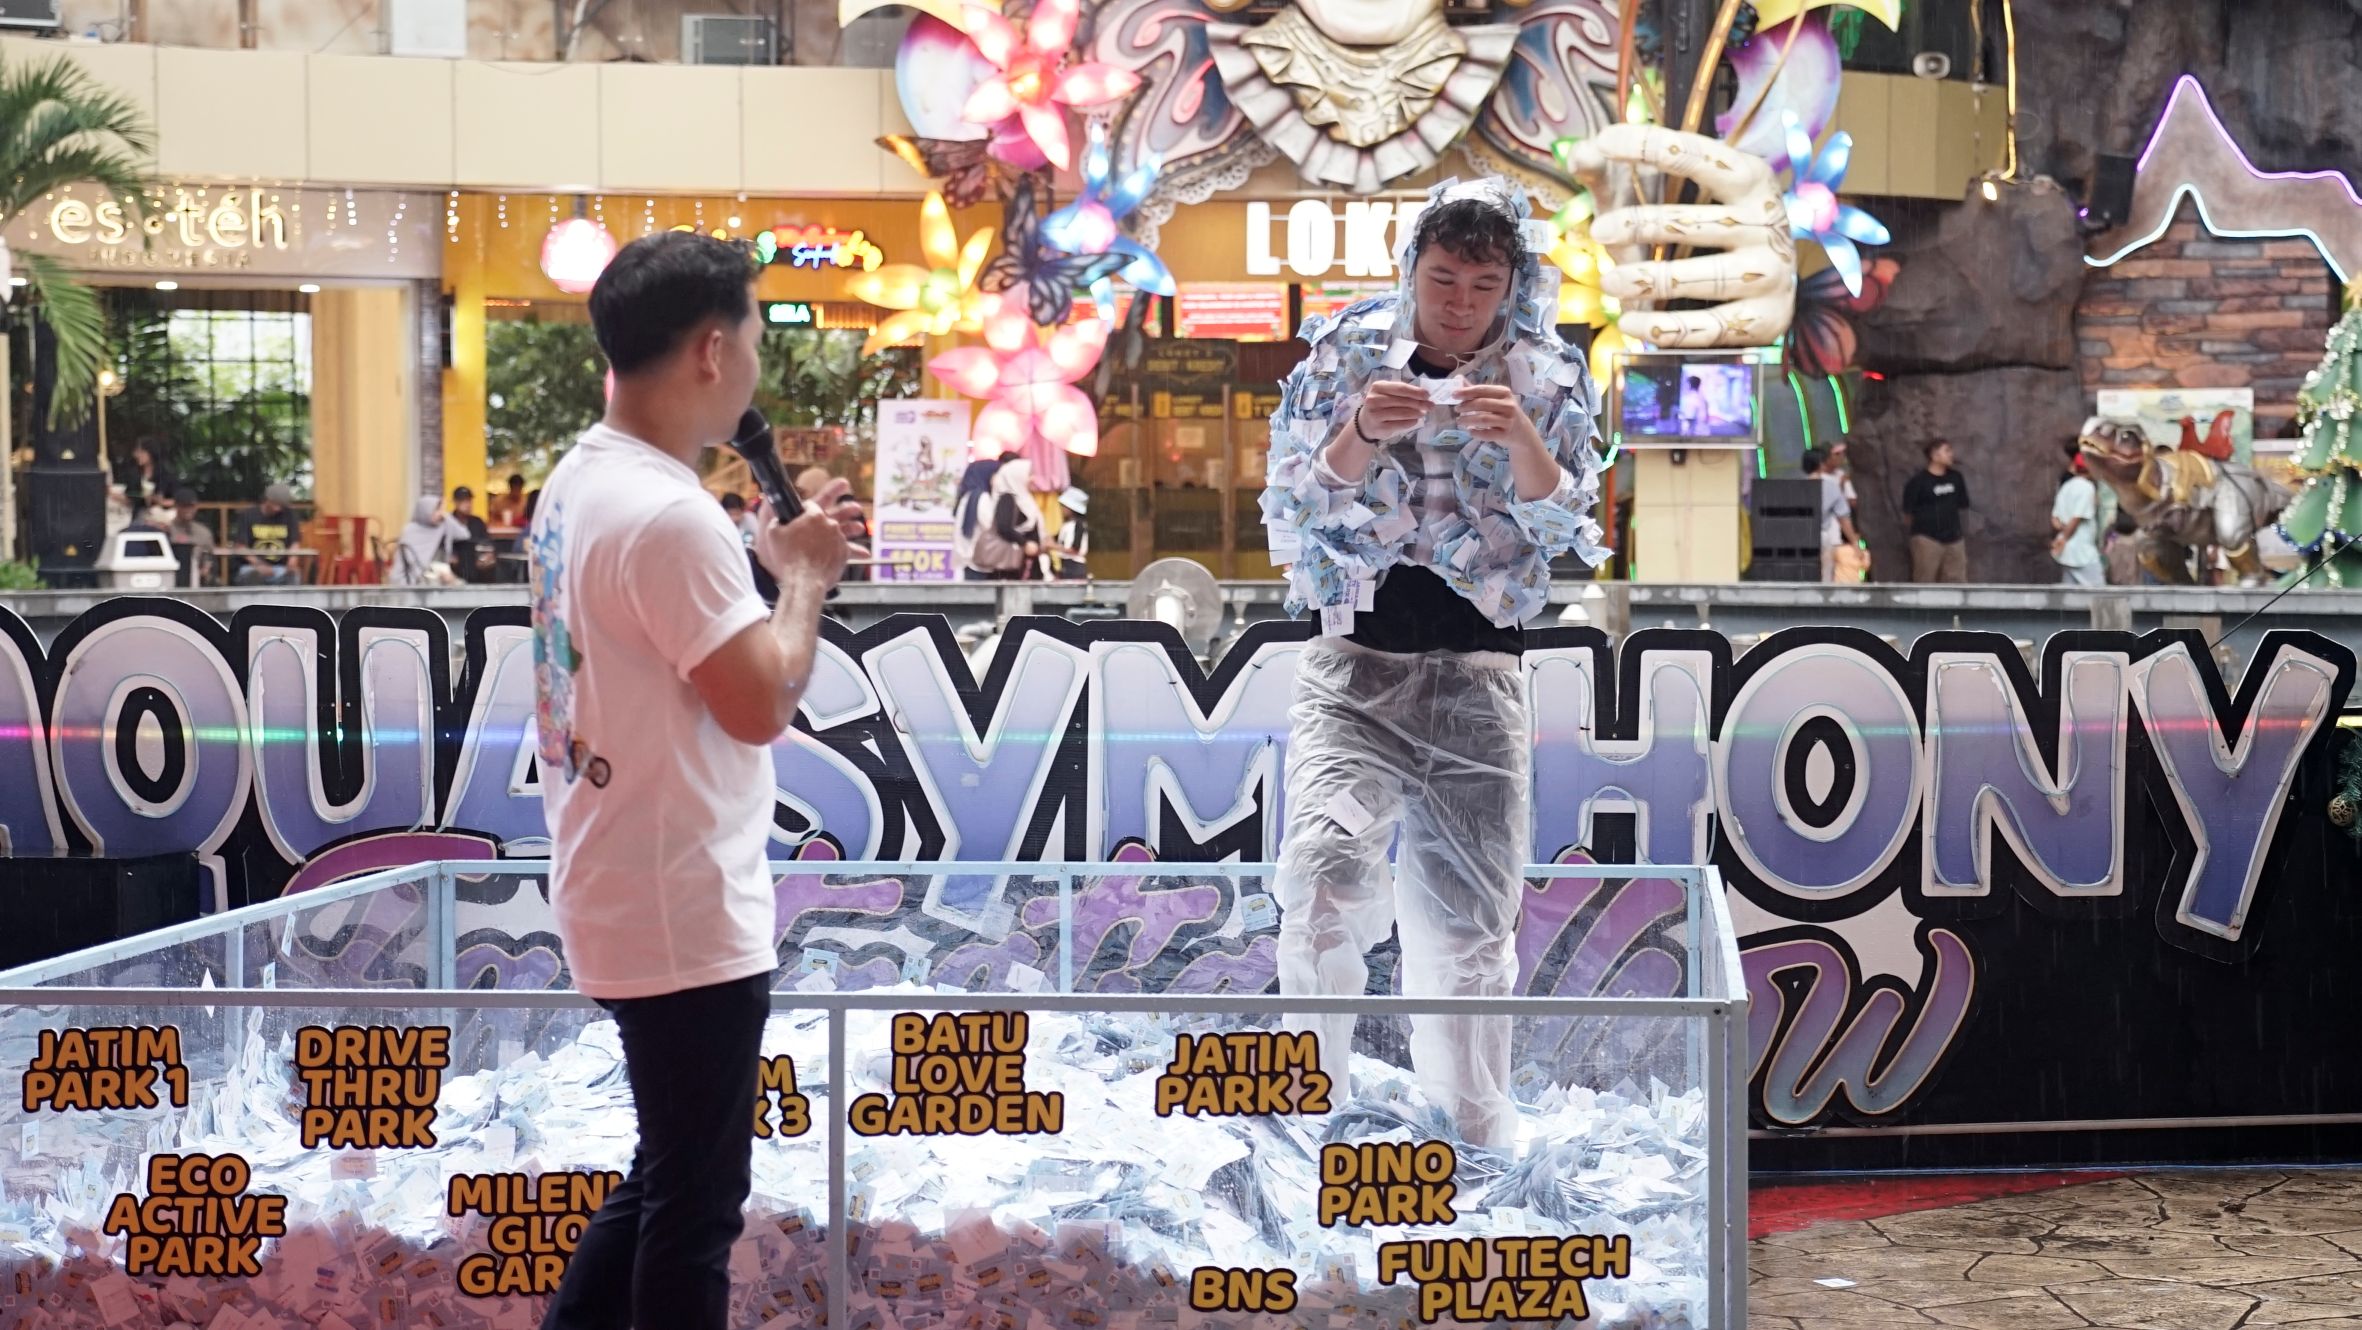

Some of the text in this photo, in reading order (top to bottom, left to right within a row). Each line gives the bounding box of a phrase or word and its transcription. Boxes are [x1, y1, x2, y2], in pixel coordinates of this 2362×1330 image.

[1246, 199, 1427, 277] LOK
[765, 624, 2340, 942] SYMHONY
[31, 1026, 180, 1072] JATIM
[296, 1026, 451, 1069] DRIVE
[892, 1013, 1029, 1055] BATU
[1166, 1030, 1319, 1077] JATIM
[24, 1066, 190, 1112] PARK 1
[300, 1066, 441, 1108] THRU
[892, 1053, 1025, 1096] LOVE
[1155, 1070, 1332, 1117] PARK 2
[301, 1106, 438, 1148] PARK
[777, 1094, 811, 1137] 3
[849, 1091, 1064, 1136] GARDEN
[147, 1153, 251, 1196] ECO
[1320, 1140, 1456, 1186] DINO
[103, 1193, 288, 1236] ACTIVE
[1318, 1182, 1457, 1228] PARK
[126, 1234, 263, 1277] PARK
[1378, 1234, 1631, 1285] FUN TECH
[1190, 1267, 1298, 1312] BNS
[1418, 1278, 1590, 1322] PLAZA
